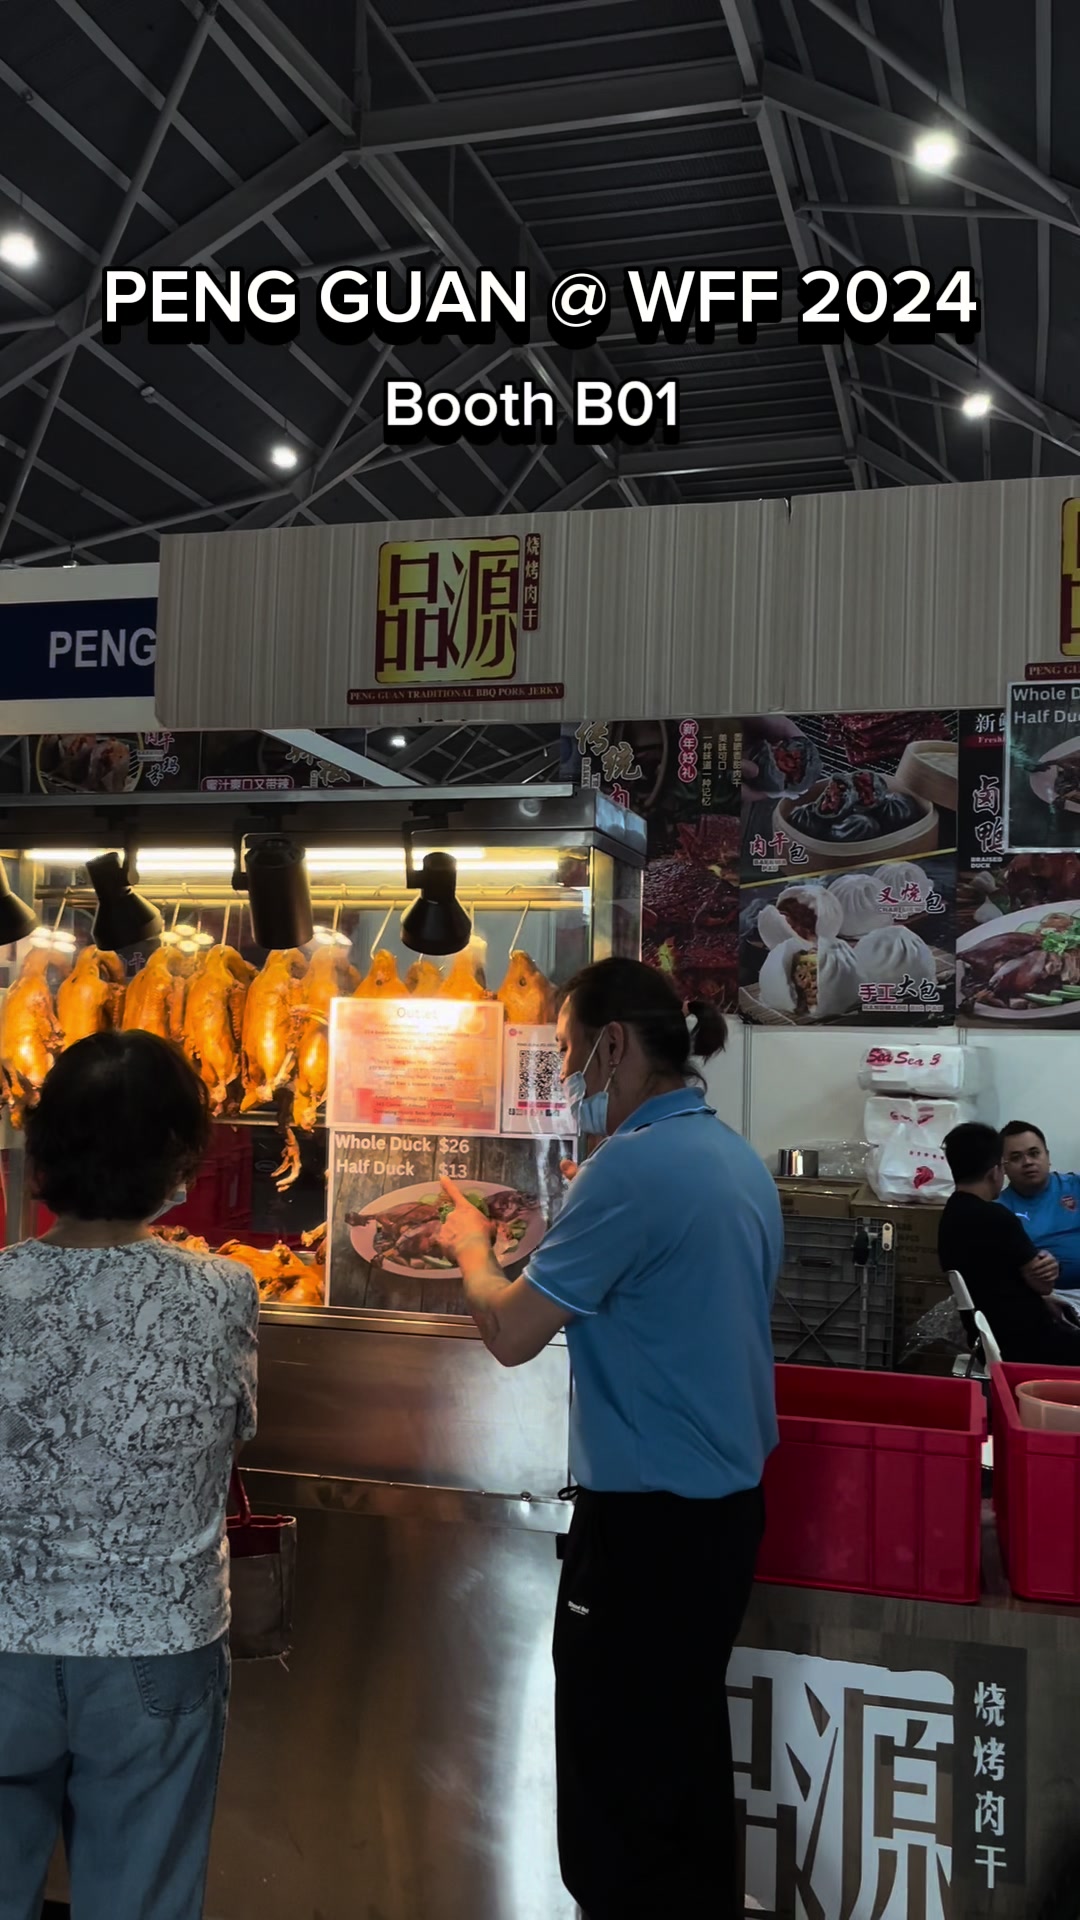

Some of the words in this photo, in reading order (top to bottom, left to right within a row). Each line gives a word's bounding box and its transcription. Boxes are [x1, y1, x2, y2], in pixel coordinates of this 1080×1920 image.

[522, 535, 541, 629] 烧烤肉干
[375, 550, 520, 673] 品源
[48, 627, 156, 669] PENG
[1029, 664, 1062, 676] PENG
[350, 691, 375, 701] PENG
[377, 690, 405, 700] GUAN
[407, 688, 475, 699] TRADITIONAL
[475, 687, 497, 698] BBQ
[498, 686, 526, 697] PORK
[527, 685, 562, 696] JERKY
[1013, 687, 1066, 701] Whole
[1014, 709, 1050, 724] Half
[1053, 709, 1080, 723] Du
[681, 722, 696, 780] 新年好礼
[750, 831, 809, 864] 肉干包
[879, 883, 945, 914] 叉烧包
[859, 975, 940, 1002] 手工大包
[335, 1134, 387, 1150] Whole
[389, 1136, 432, 1152] Duck
[438, 1137, 470, 1154] $26
[336, 1159, 371, 1174] Half
[373, 1160, 415, 1177] Duck
[438, 1162, 468, 1179] $13
[973, 1680, 1008, 1890] 烧烤肉干
